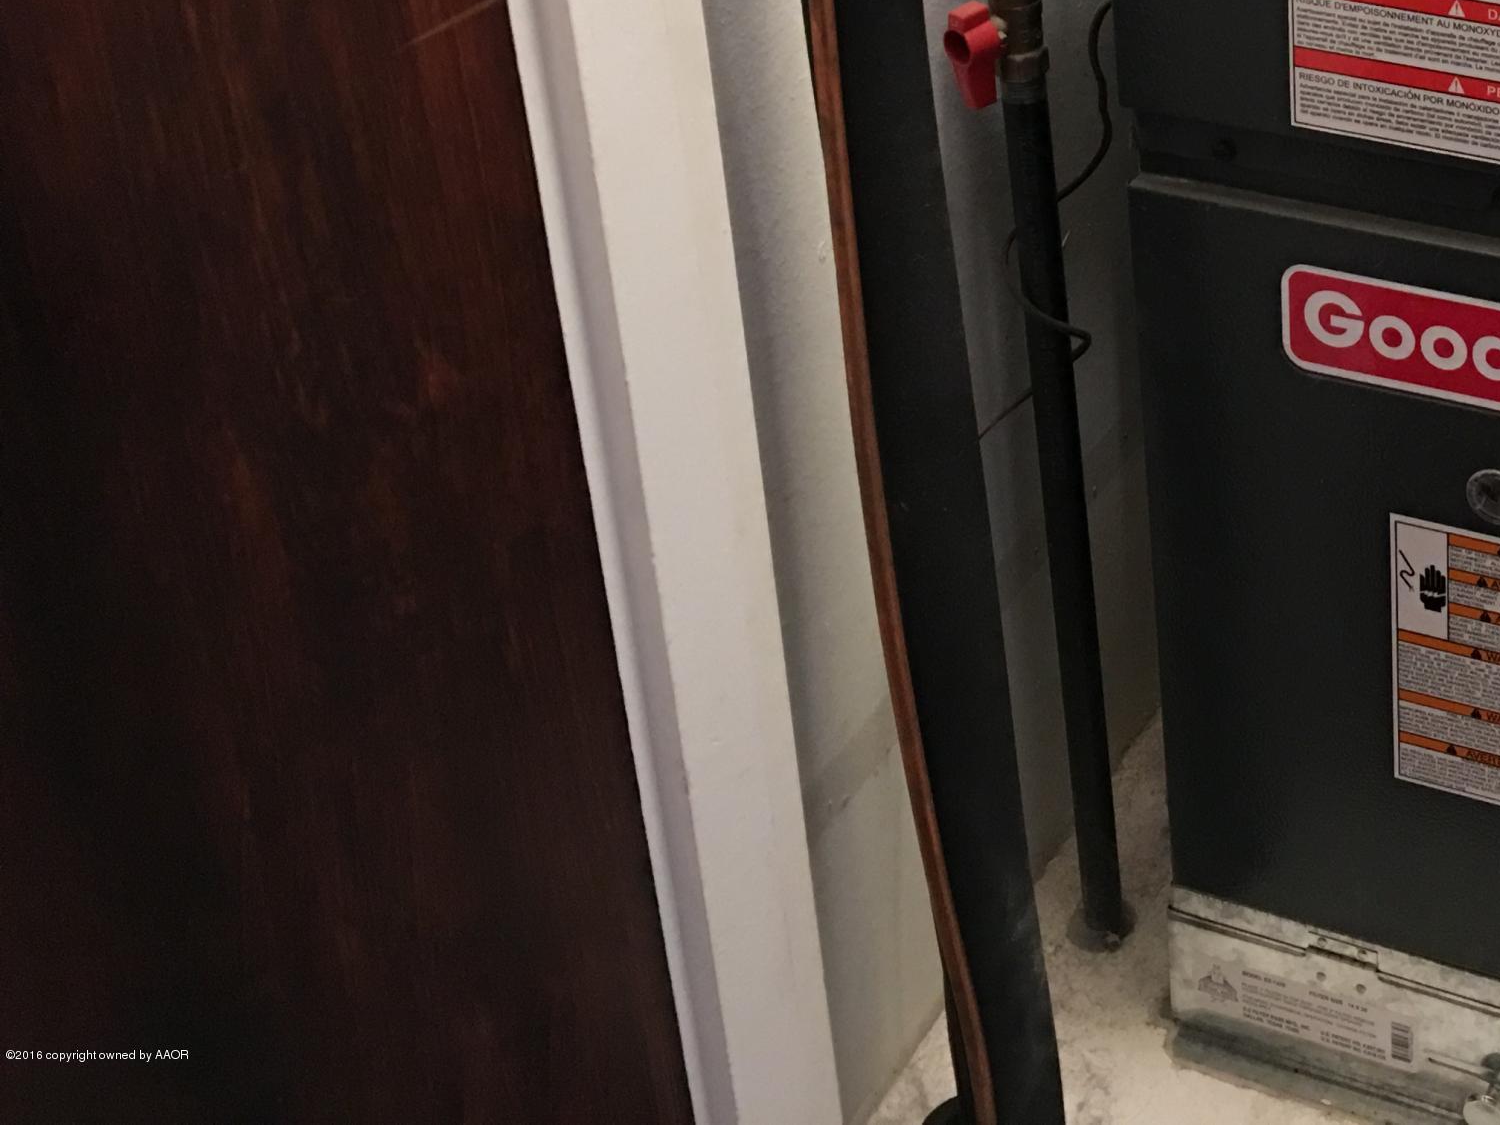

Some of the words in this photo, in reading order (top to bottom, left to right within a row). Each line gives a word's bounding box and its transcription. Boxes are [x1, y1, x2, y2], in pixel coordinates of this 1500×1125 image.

[1437, 19, 1450, 28] AU
[1298, 71, 1335, 85] RIESGO
[1337, 78, 1350, 88] DE
[1423, 94, 1443, 105] POR
